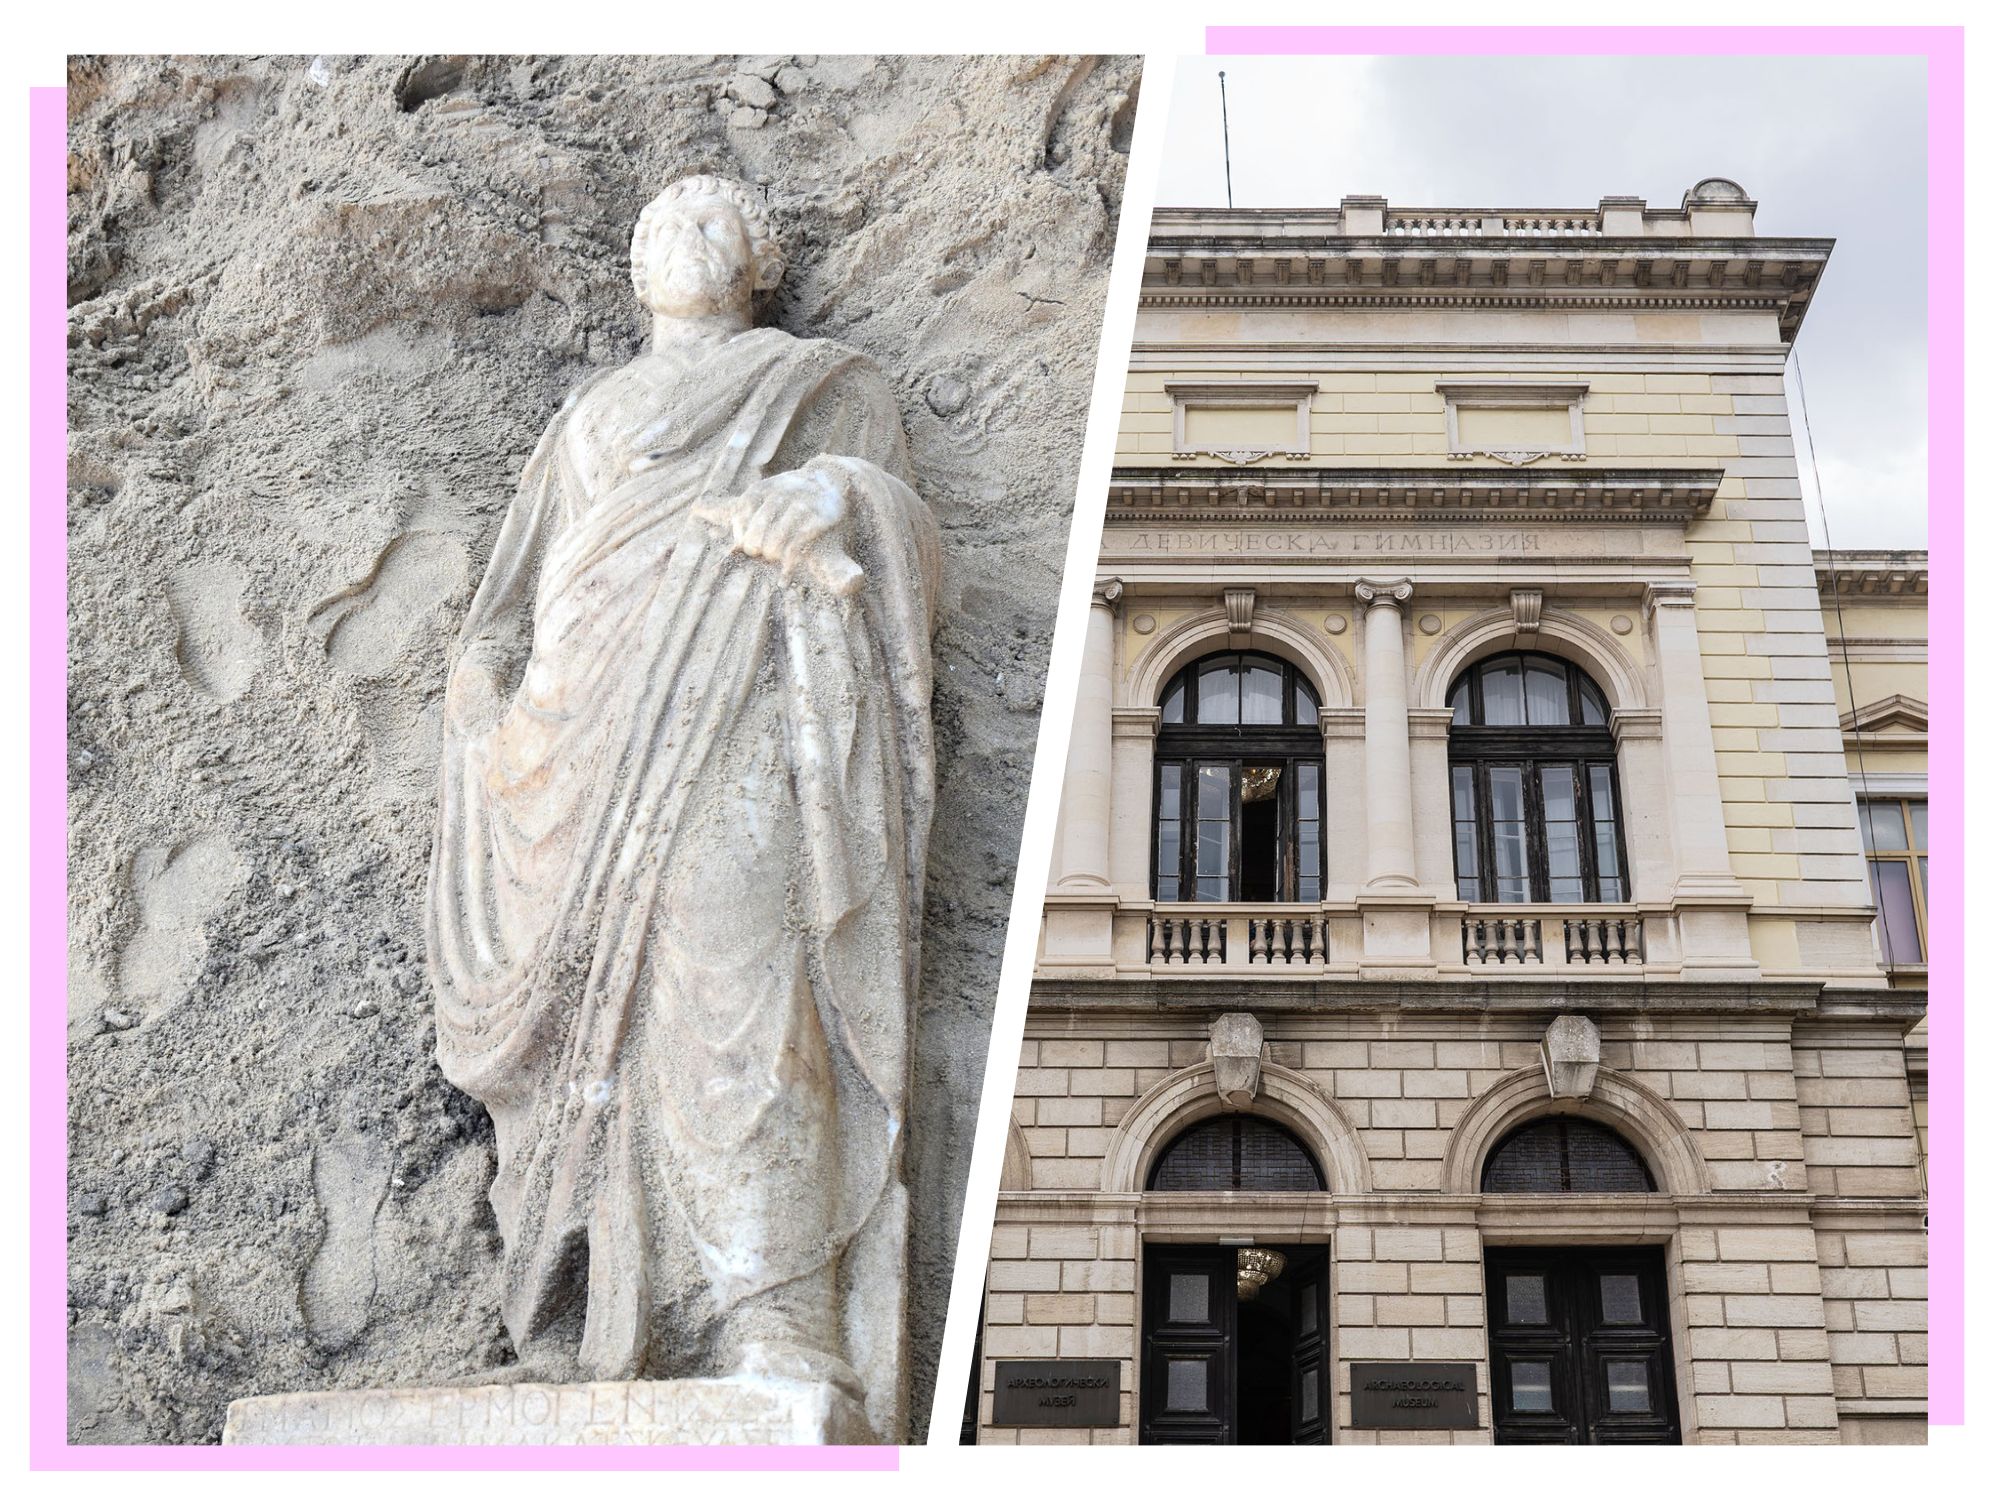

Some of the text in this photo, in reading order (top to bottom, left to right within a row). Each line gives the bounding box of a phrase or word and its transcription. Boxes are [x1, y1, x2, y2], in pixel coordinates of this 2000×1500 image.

[1129, 533, 1333, 552] ДЕВИЧЕСКА
[1352, 533, 1541, 552] ГИМНАЗИЯ
[1006, 1376, 1110, 1389] АРХЕОЛОГИЧЕСКИ
[1362, 1378, 1466, 1392] ARCHAEOLOGICAL
[1038, 1393, 1077, 1408] МУЗЕЙ
[1392, 1397, 1439, 1409] MUSEUM
